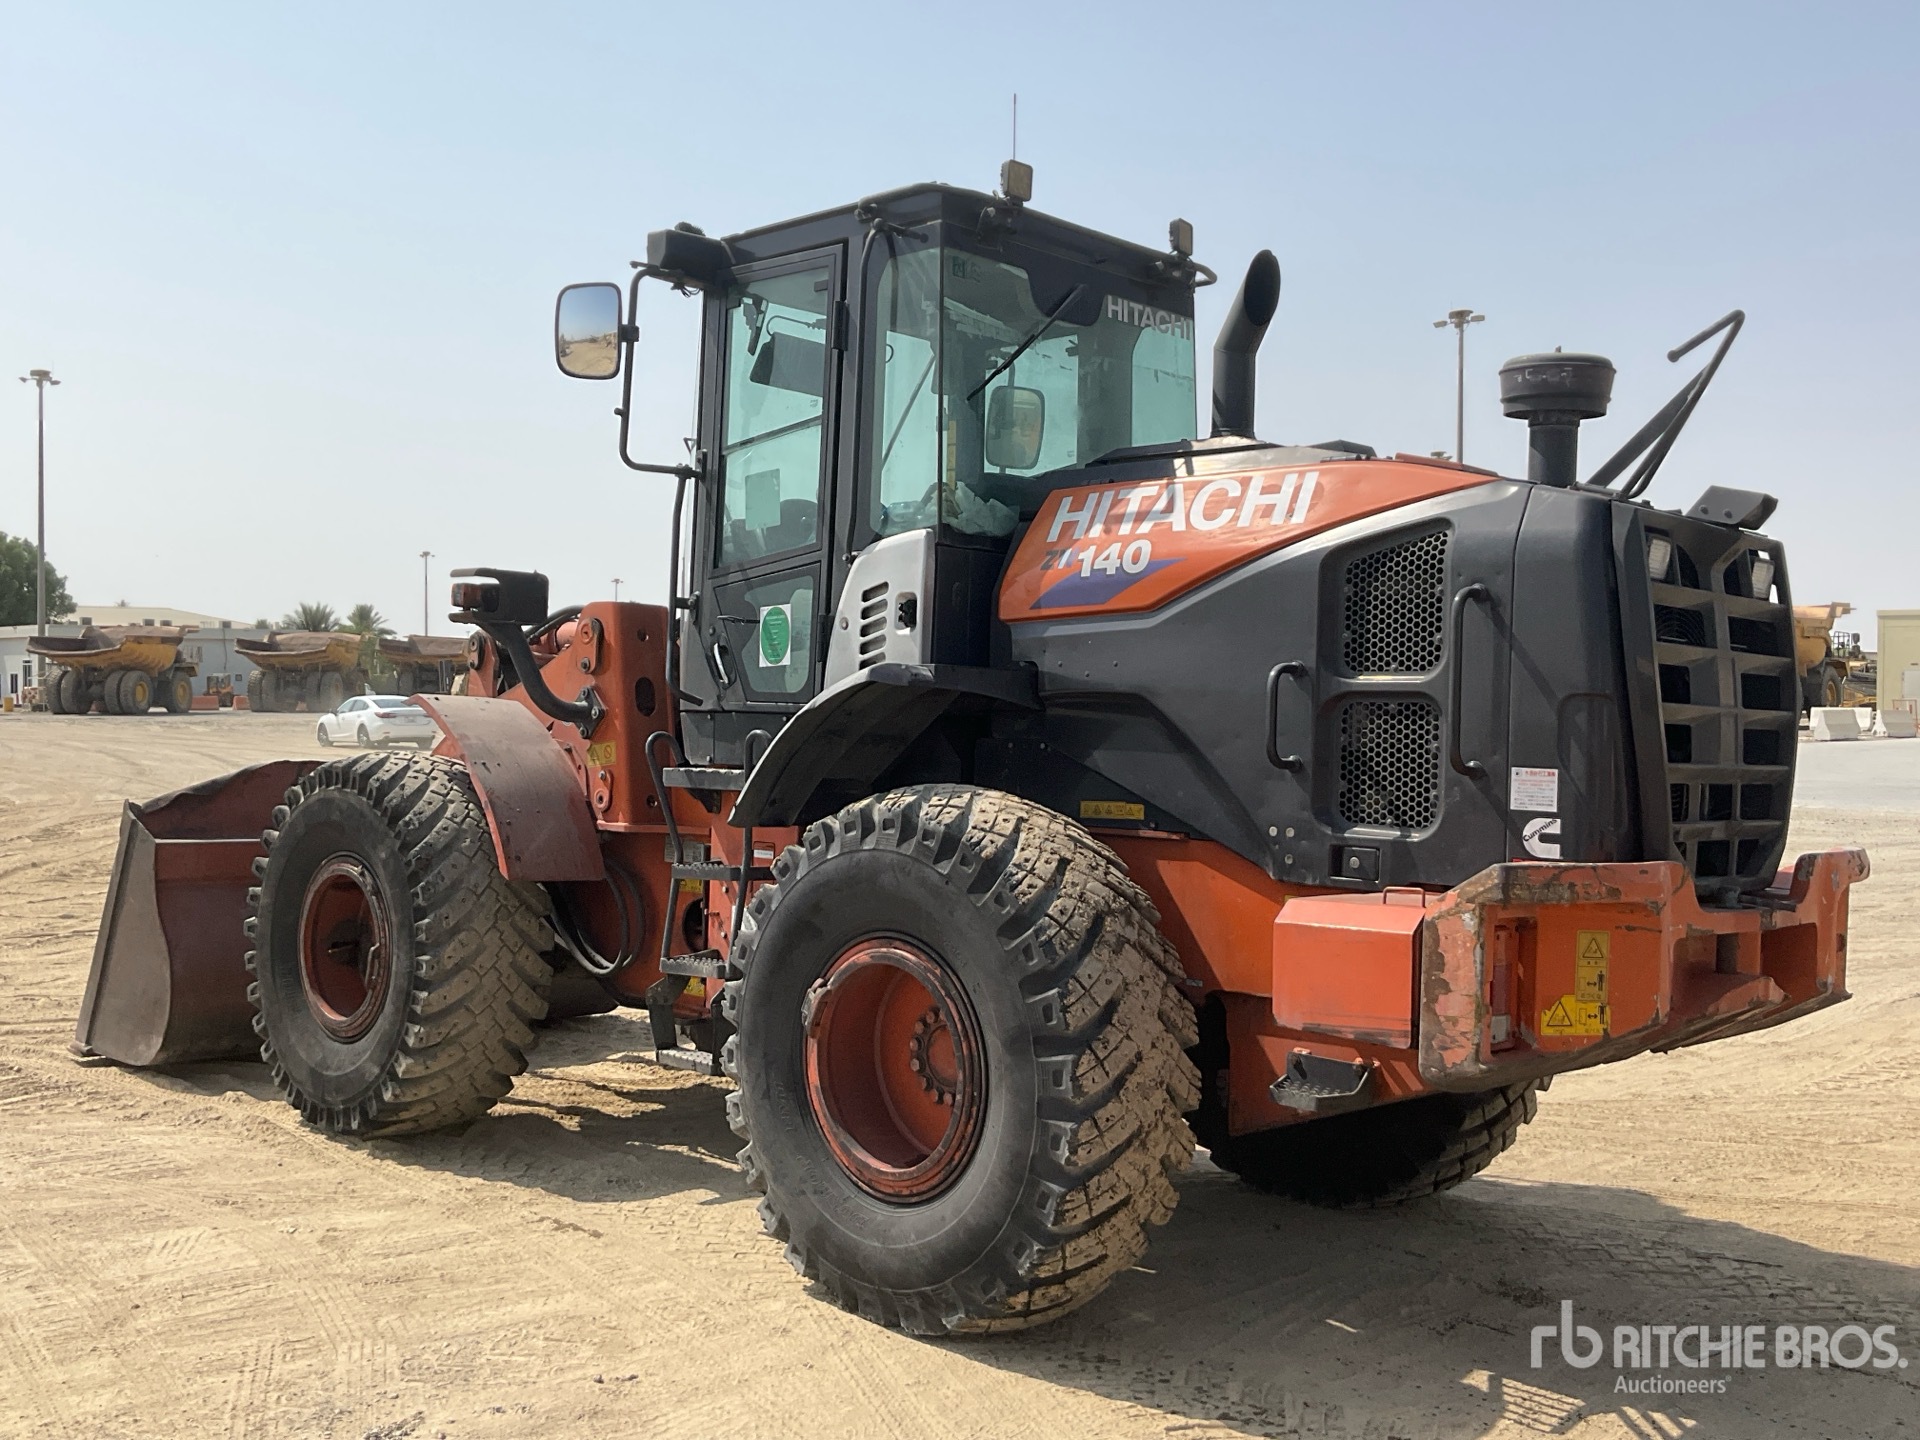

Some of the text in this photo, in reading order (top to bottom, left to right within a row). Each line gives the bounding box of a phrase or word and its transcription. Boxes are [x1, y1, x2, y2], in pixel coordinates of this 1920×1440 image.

[1106, 294, 1193, 341] HITACHI
[1046, 470, 1320, 543] HITACHI
[1522, 818, 1558, 842] Cummins
